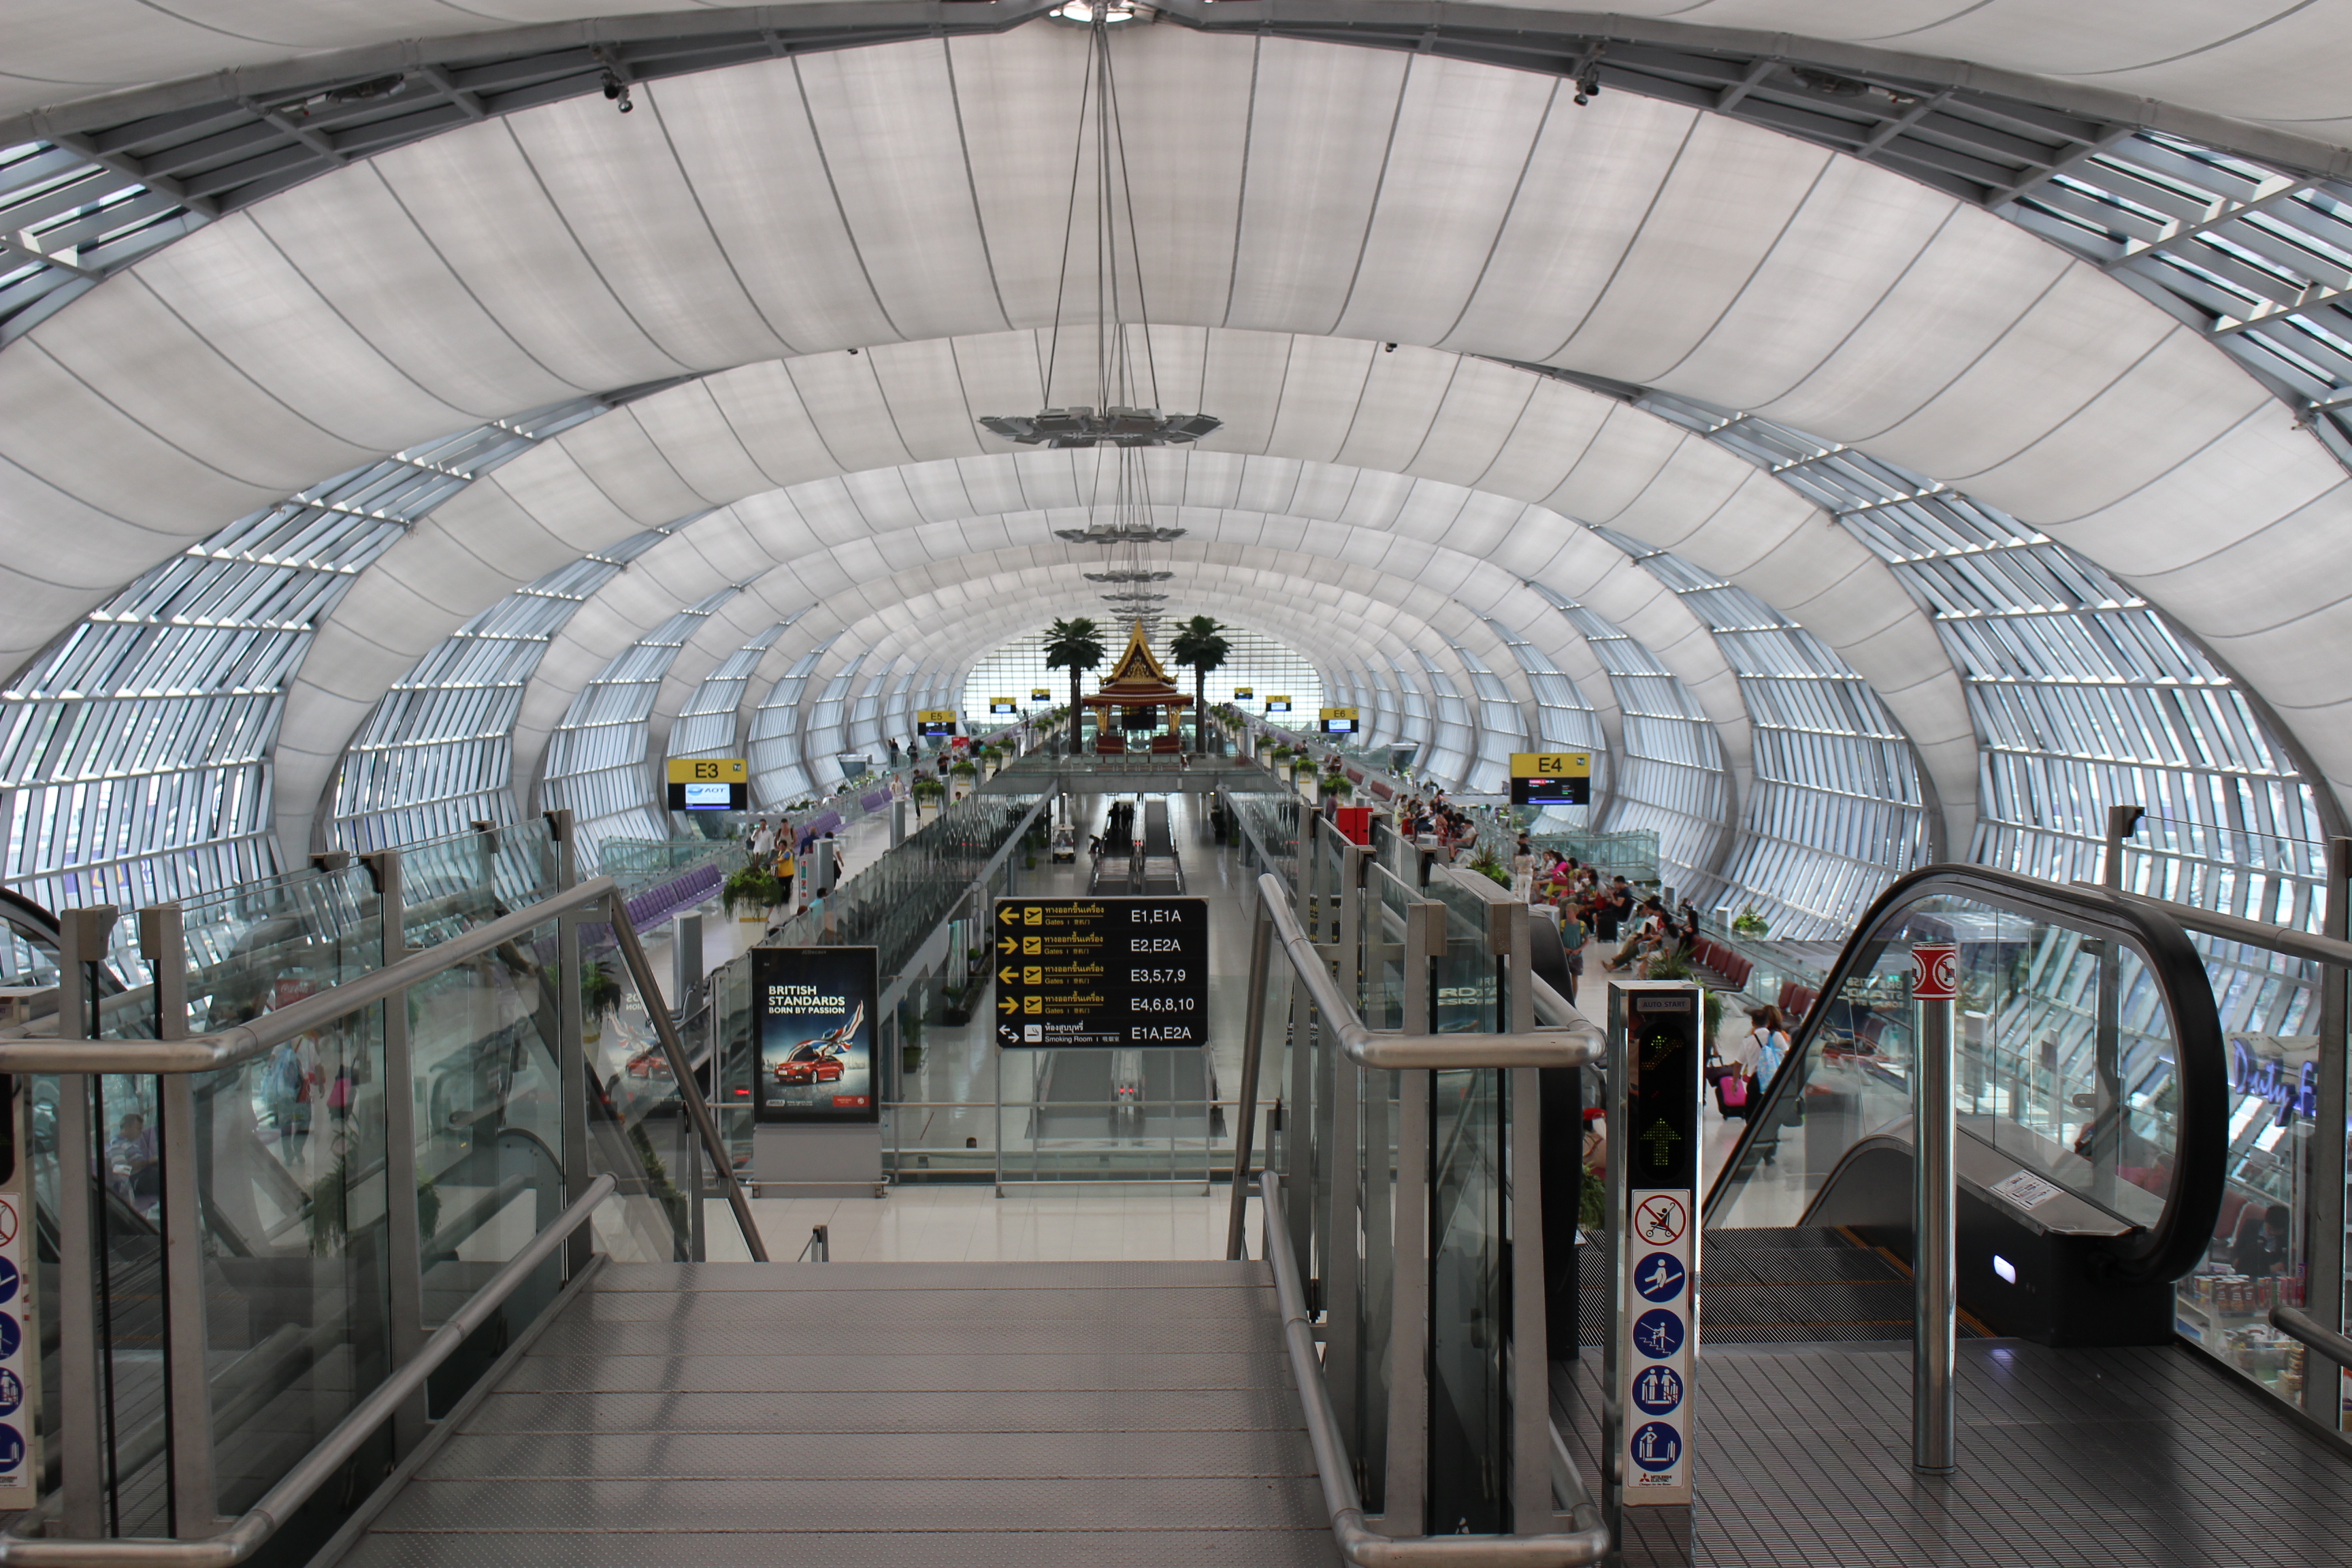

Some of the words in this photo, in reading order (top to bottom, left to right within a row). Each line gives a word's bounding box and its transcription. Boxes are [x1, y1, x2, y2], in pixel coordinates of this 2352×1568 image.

[930, 713, 943, 721] E5
[1334, 710, 1345, 718] E6
[696, 763, 719, 779] E3
[1539, 757, 1563, 772] E4
[1045, 902, 1104, 913] ทางออกขึ้นเครื่อง
[1131, 909, 1181, 924] E1,E1A
[1044, 931, 1103, 943] ทางออกขึ้นเครื่อง
[1130, 939, 1181, 954] E2,E2A
[1045, 961, 1104, 973] ทางออกขึ้นเครื่อง
[1130, 969, 1186, 984] E3,5,7,9
[768, 985, 817, 995] BRITISH
[1045, 991, 1104, 1002] ทางออกขึ้นเครื่อง
[768, 996, 845, 1006] STANDARDS
[1131, 998, 1194, 1013] E4,6,8,10
[1045, 1020, 1083, 1033] ห้องสูบบุหรี่
[1131, 1026, 1192, 1041] E1A,E2A
[2233, 1037, 2291, 1127] Duty
